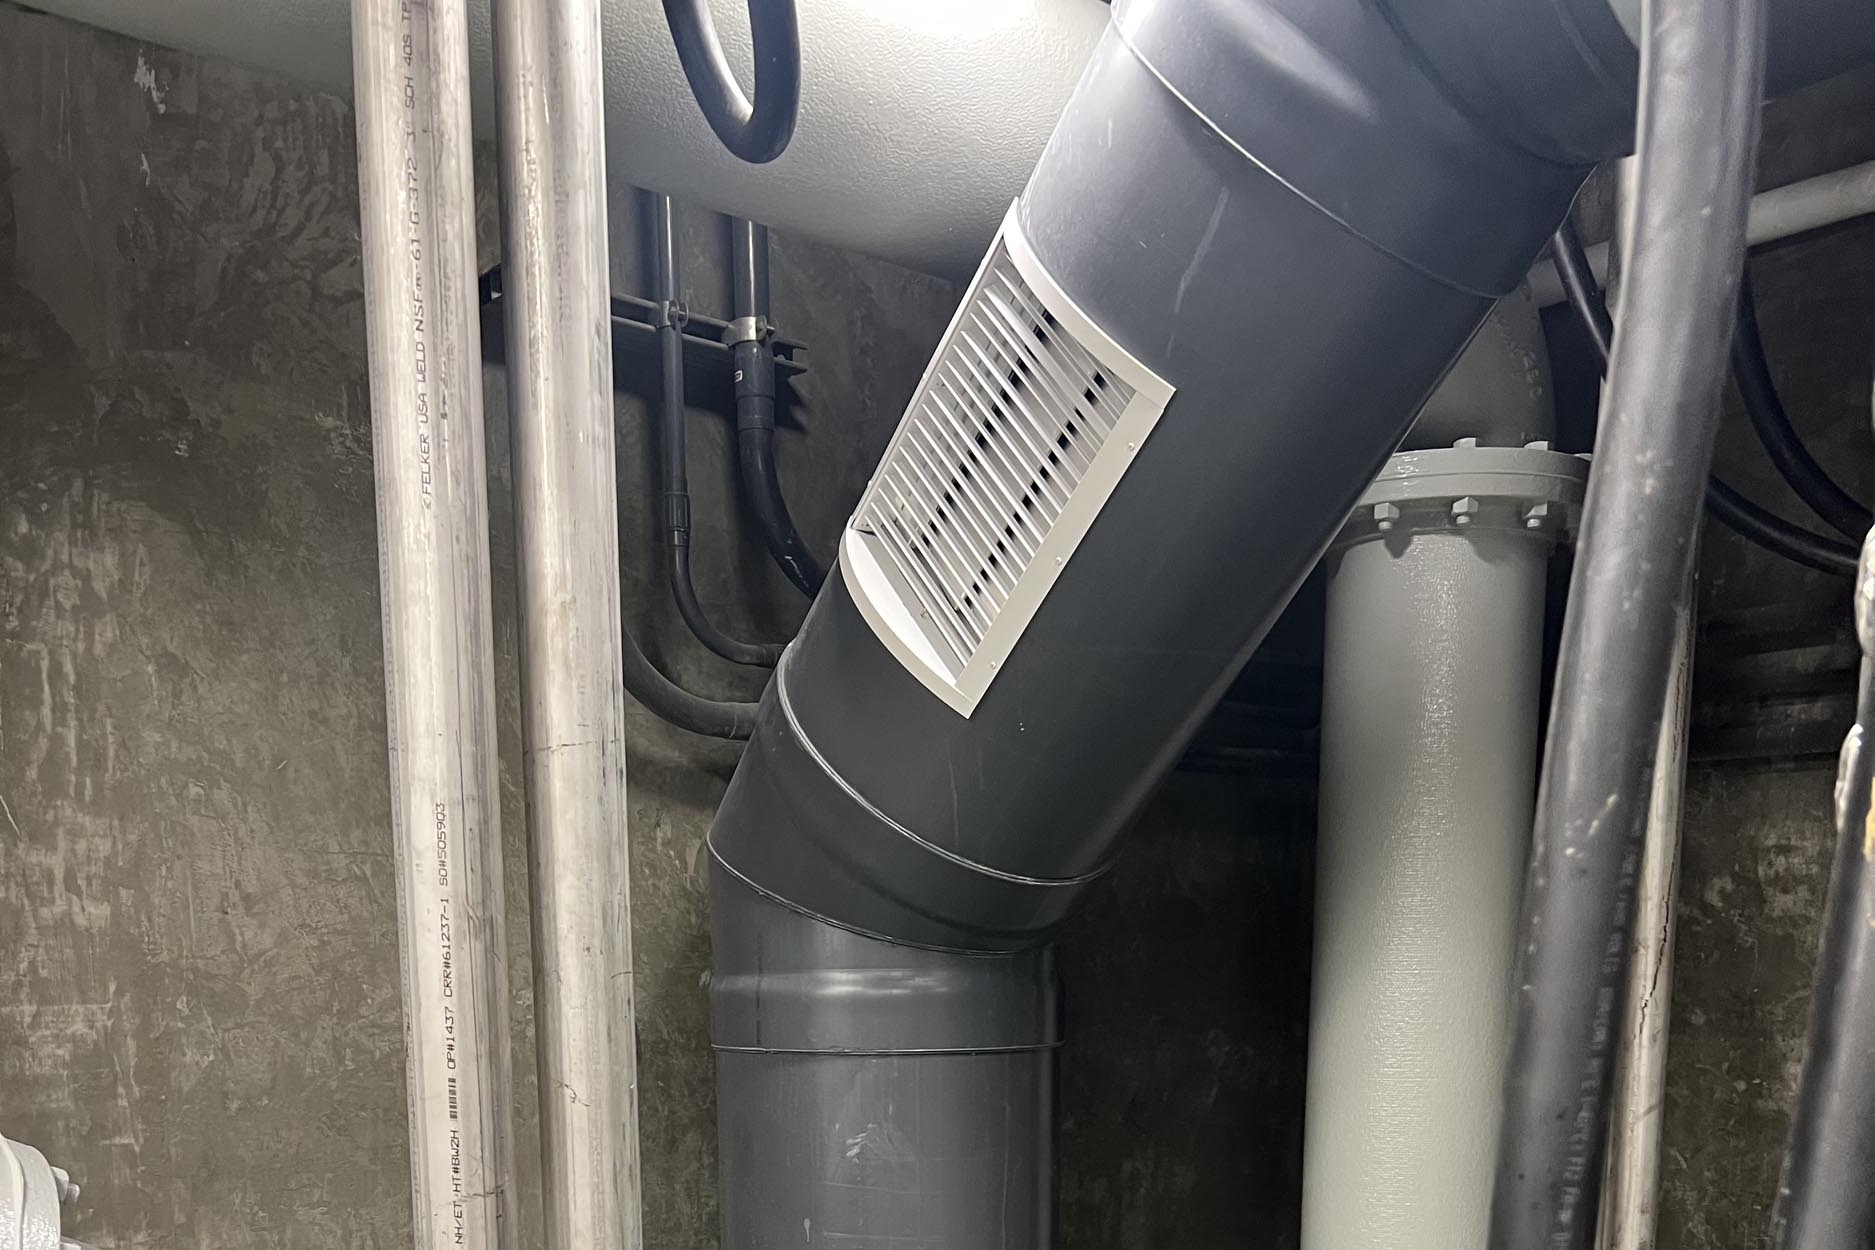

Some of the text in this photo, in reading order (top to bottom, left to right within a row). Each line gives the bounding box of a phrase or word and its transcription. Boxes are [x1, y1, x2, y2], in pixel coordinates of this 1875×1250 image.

[404, 76, 415, 110] SCH
[416, 342, 426, 382] WELD
[418, 393, 428, 424] USA
[435, 802, 448, 886] SO#505903
[440, 898, 453, 998] CRR#61237-1
[452, 1200, 464, 1244] NH/ET
